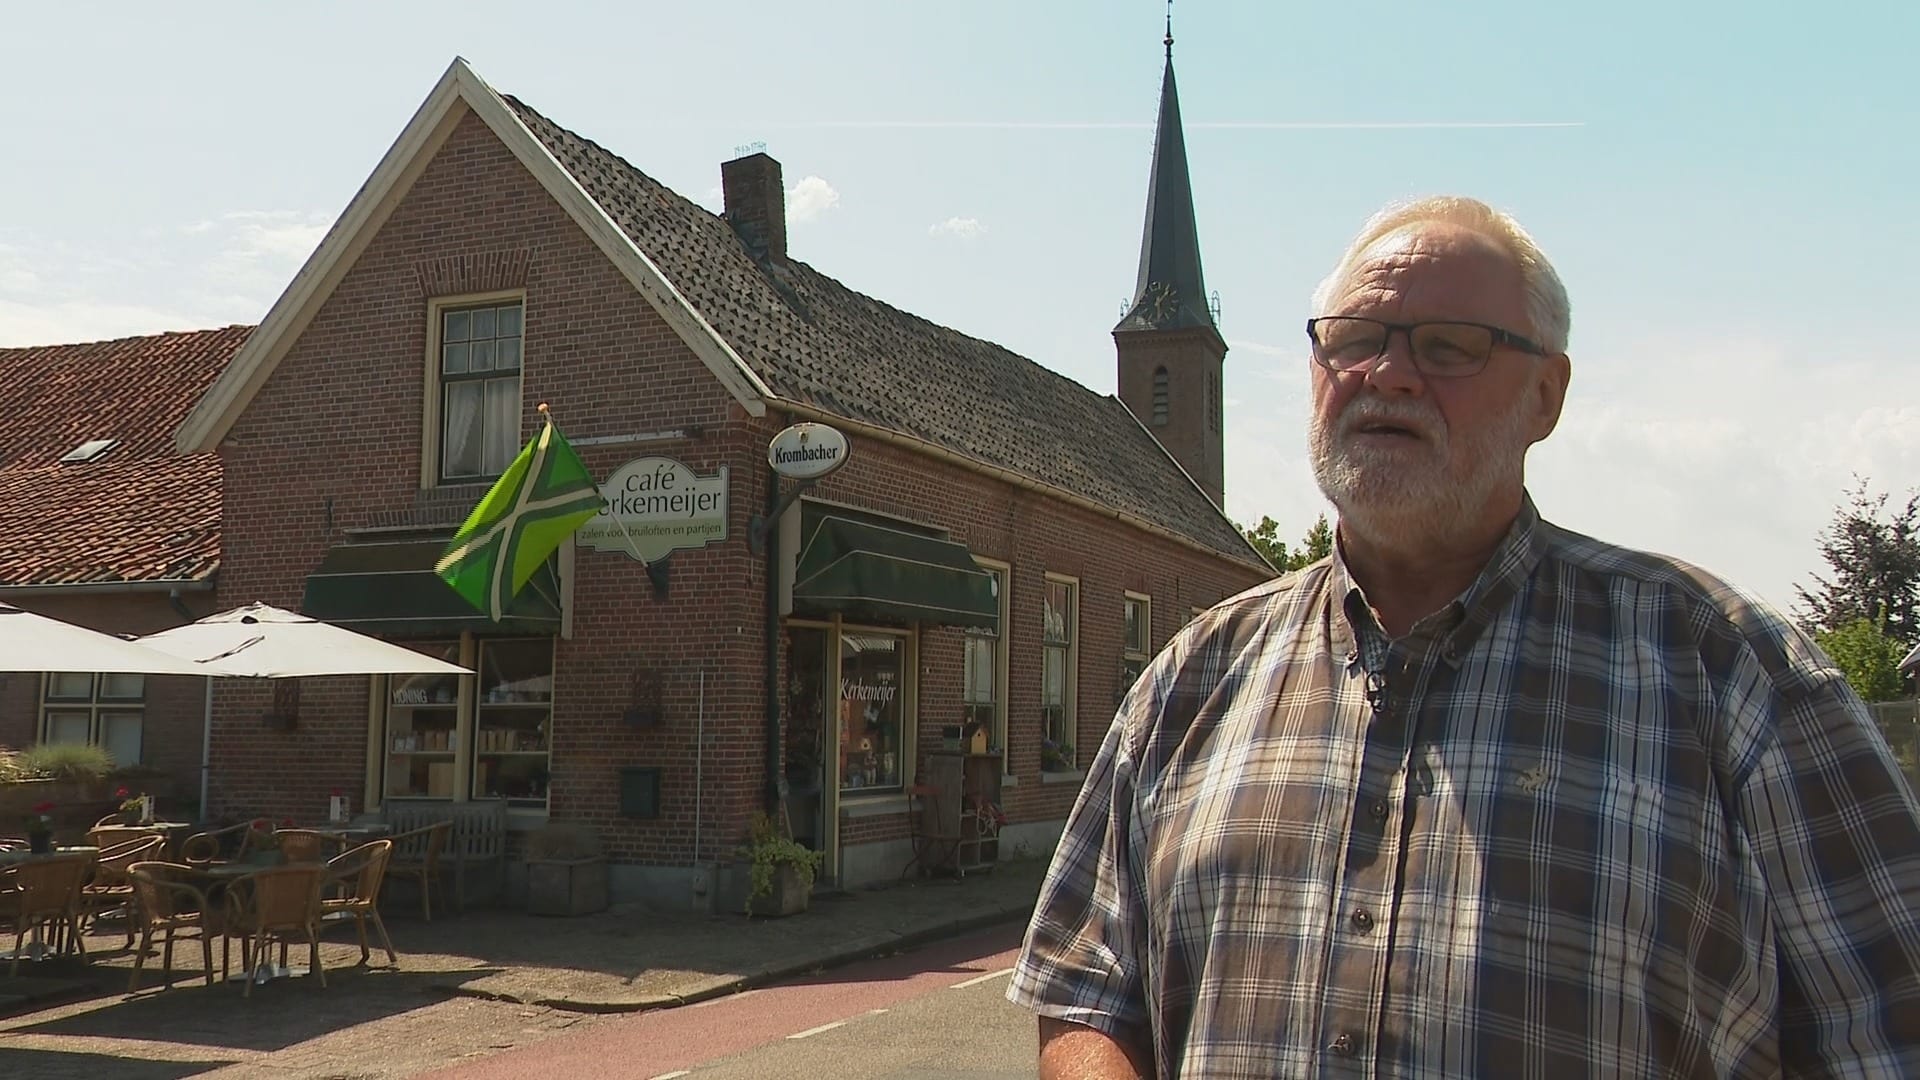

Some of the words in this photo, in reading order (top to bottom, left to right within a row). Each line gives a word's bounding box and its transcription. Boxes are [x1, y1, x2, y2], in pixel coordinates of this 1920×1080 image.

[775, 443, 838, 464] Krombacher
[625, 463, 676, 492] café
[598, 487, 721, 518] erkemeijer
[582, 527, 605, 539] zalen
[607, 529, 624, 538] voo
[628, 524, 671, 537] bruiloften
[673, 527, 685, 536] en
[686, 523, 722, 536] partijen
[840, 676, 897, 710] Kerkemeijer
